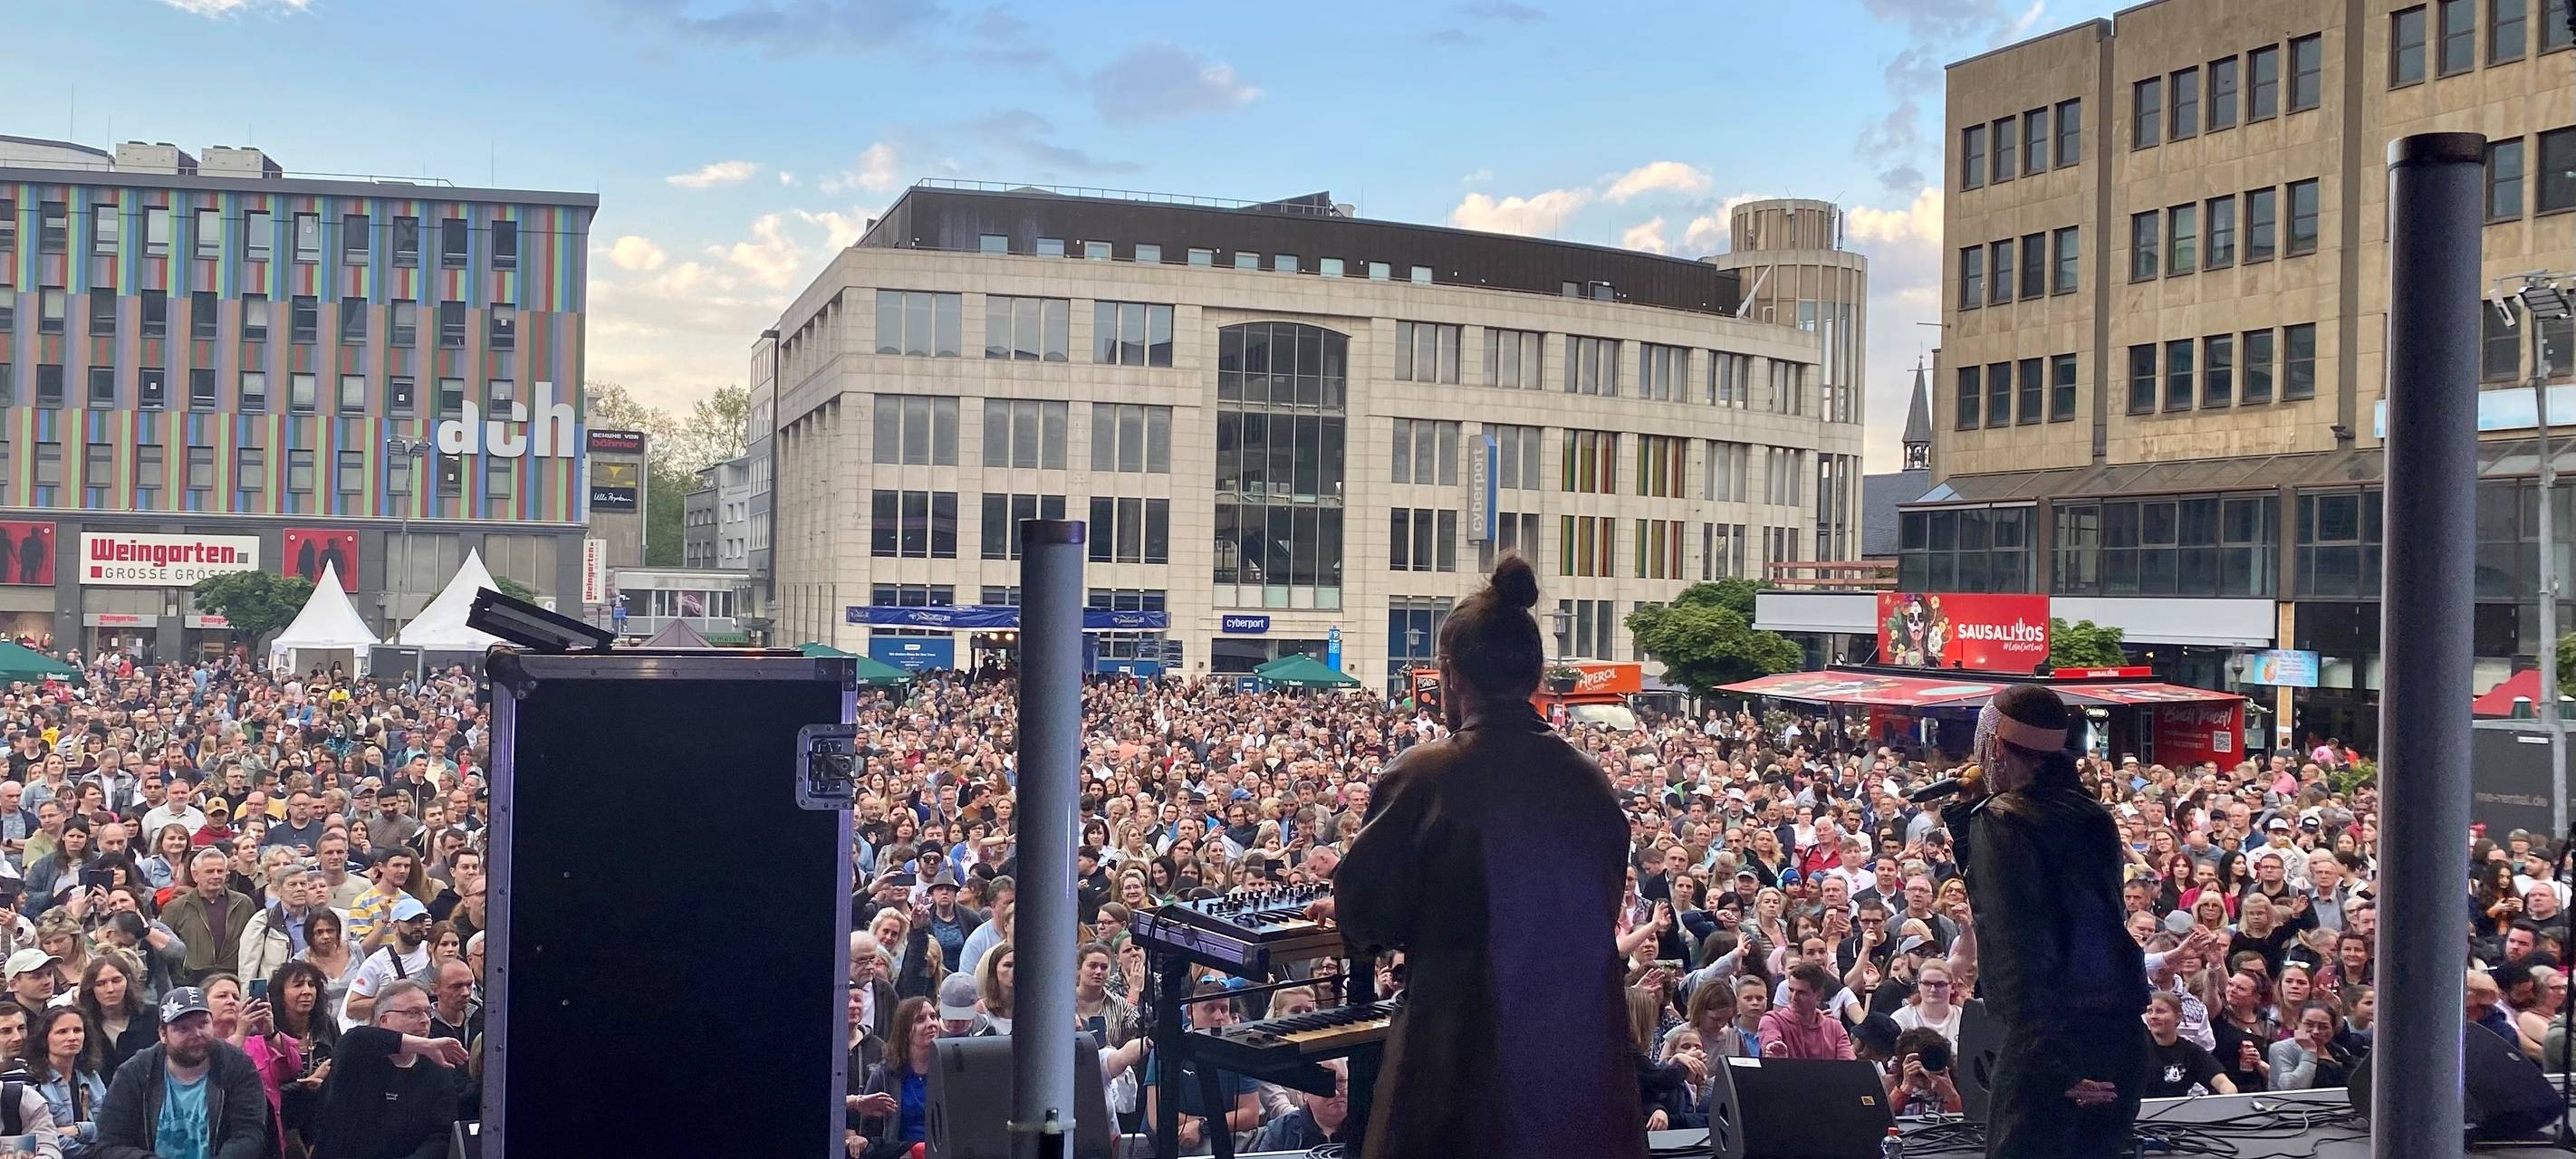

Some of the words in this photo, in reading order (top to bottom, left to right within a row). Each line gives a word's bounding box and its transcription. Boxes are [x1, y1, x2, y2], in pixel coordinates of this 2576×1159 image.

[1473, 448, 1485, 532] cyberport
[91, 538, 235, 567] Weingarten
[105, 568, 168, 580] GROSSE
[585, 547, 595, 600] Weingarten
[1226, 618, 1264, 628] cyberport
[1579, 668, 1618, 688] APEROL
[187, 986, 199, 1006] TYR
